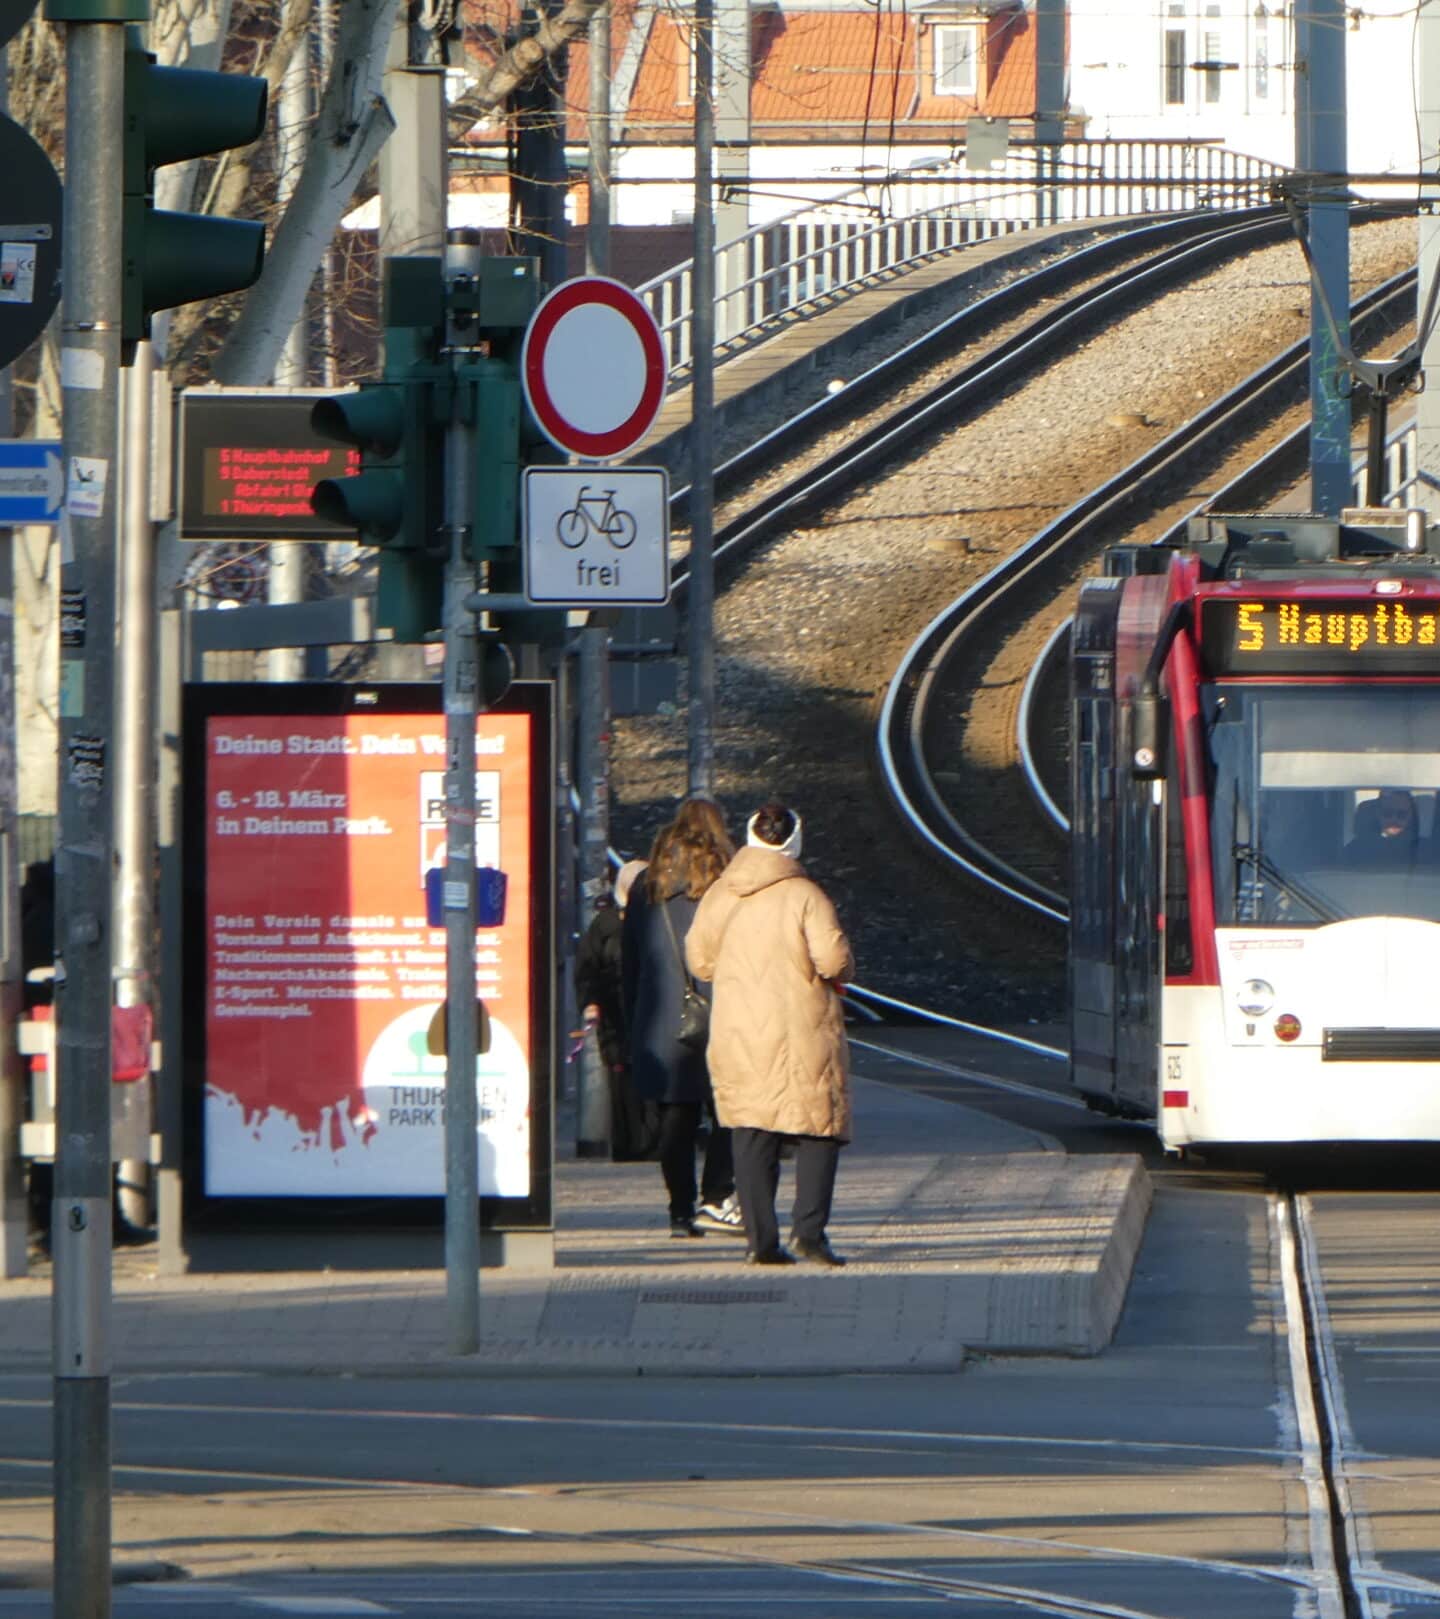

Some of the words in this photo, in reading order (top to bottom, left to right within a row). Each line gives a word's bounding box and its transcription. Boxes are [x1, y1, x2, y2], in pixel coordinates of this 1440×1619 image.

[232, 449, 330, 464] Hauptbahnhof
[576, 558, 621, 587] frei
[1238, 603, 1264, 651] 5
[214, 735, 283, 754] Deine
[287, 735, 358, 754] Stadt.
[361, 735, 417, 754] Dein
[215, 790, 237, 808] 6.
[254, 790, 285, 808] 18.
[288, 790, 347, 808] März
[216, 817, 240, 834] in
[245, 817, 329, 834] Deinem
[334, 817, 393, 834] Park.
[214, 914, 255, 928] Dein
[263, 914, 321, 928] Verein
[214, 932, 284, 945] Vorstand
[289, 932, 320, 945] und
[389, 1107, 437, 1126] PARK
